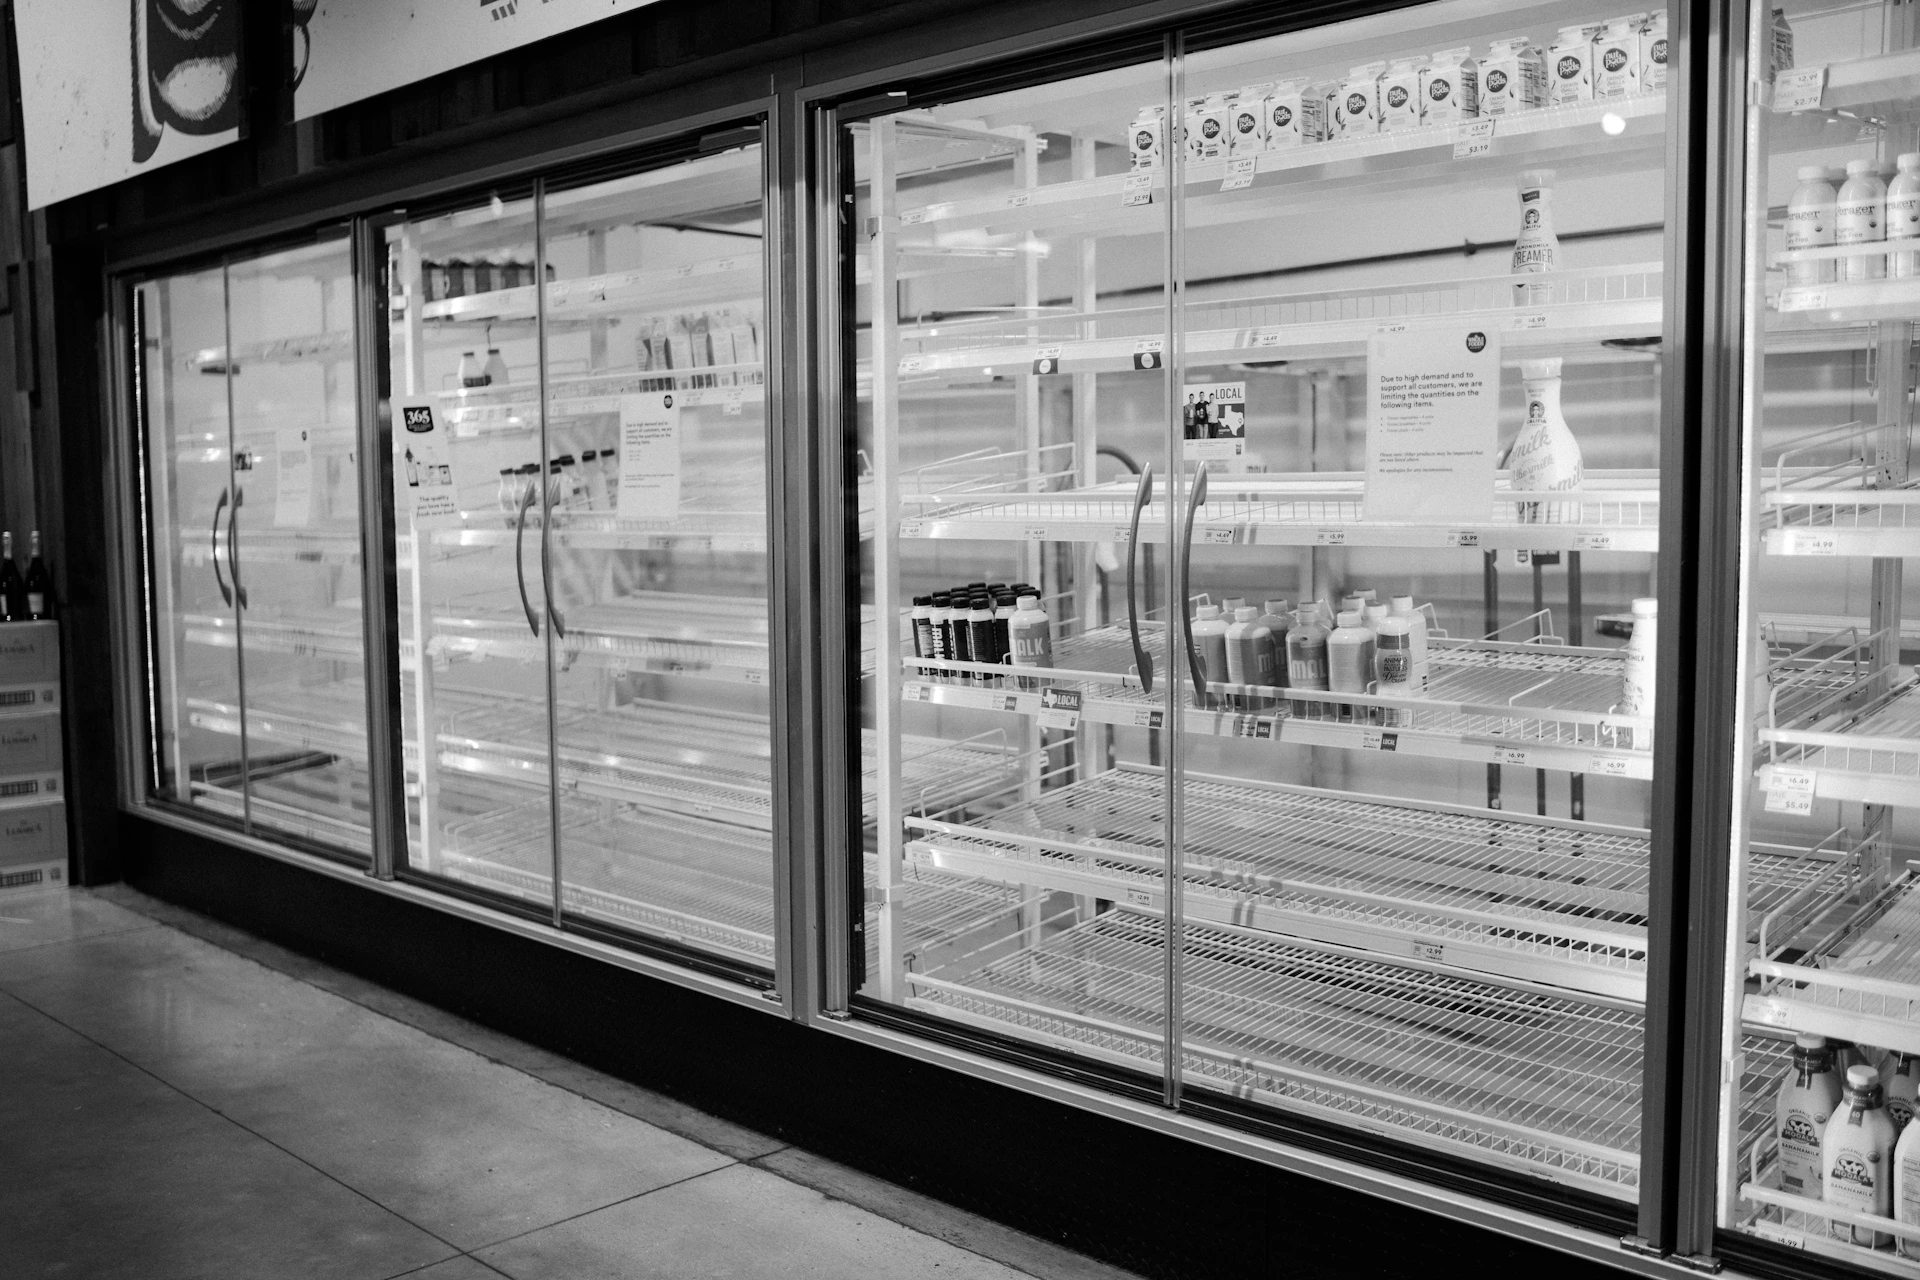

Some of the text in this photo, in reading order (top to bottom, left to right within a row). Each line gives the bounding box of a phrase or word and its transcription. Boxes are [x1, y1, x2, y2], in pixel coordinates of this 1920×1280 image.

[1653, 42, 1667, 51] nut
[1605, 51, 1619, 60] nut
[1559, 59, 1573, 68] nut
[1605, 56, 1627, 67] pods
[1559, 64, 1580, 75] pods
[1488, 73, 1500, 82] nut
[1431, 81, 1443, 90] nut
[1488, 78, 1506, 88] pods
[1389, 88, 1401, 97] nut
[1431, 86, 1450, 96] pods
[1349, 95, 1360, 104] nut
[1389, 92, 1407, 103] pods
[1349, 100, 1366, 110] pods
[1275, 108, 1286, 117] nut
[1275, 112, 1292, 123] pods
[1203, 121, 1214, 129] nut
[1238, 116, 1249, 124] nut
[1238, 119, 1255, 129] pods
[1203, 124, 1220, 134] pods
[1137, 133, 1148, 141] nut
[1137, 138, 1153, 147] pods
[1469, 145, 1489, 153] $3.19
[1513, 249, 1554, 268] CREAMER
[1404, 374, 1419, 383] high
[1381, 384, 1407, 392] support
[1418, 382, 1457, 390] customers,
[1215, 387, 1243, 400] LOCAL
[1380, 393, 1406, 401] limiting
[1420, 390, 1454, 399] quantities
[1380, 401, 1412, 409] following
[407, 409, 430, 425] 365
[1557, 459, 1585, 491] mil
[1016, 637, 1044, 657] ALK
[1057, 694, 1079, 707] LOCAL
[1789, 777, 1809, 785] $6.49
[1785, 800, 1809, 810] $5.49
[1426, 947, 1442, 956] $2.99
[1887, 1096, 1912, 1106] ORGANIC
[1788, 1108, 1812, 1119] ORGANIC
[1851, 1110, 1861, 1119] 60
[1784, 1129, 1817, 1143] MOOALA
[1781, 1142, 1820, 1157] BANANAMILK
[1839, 1147, 1864, 1158] ORGANIC
[1834, 1168, 1868, 1183] MOOALA
[1830, 1182, 1874, 1198] BANANAMILK
[1777, 1236, 1798, 1247] $4.99
